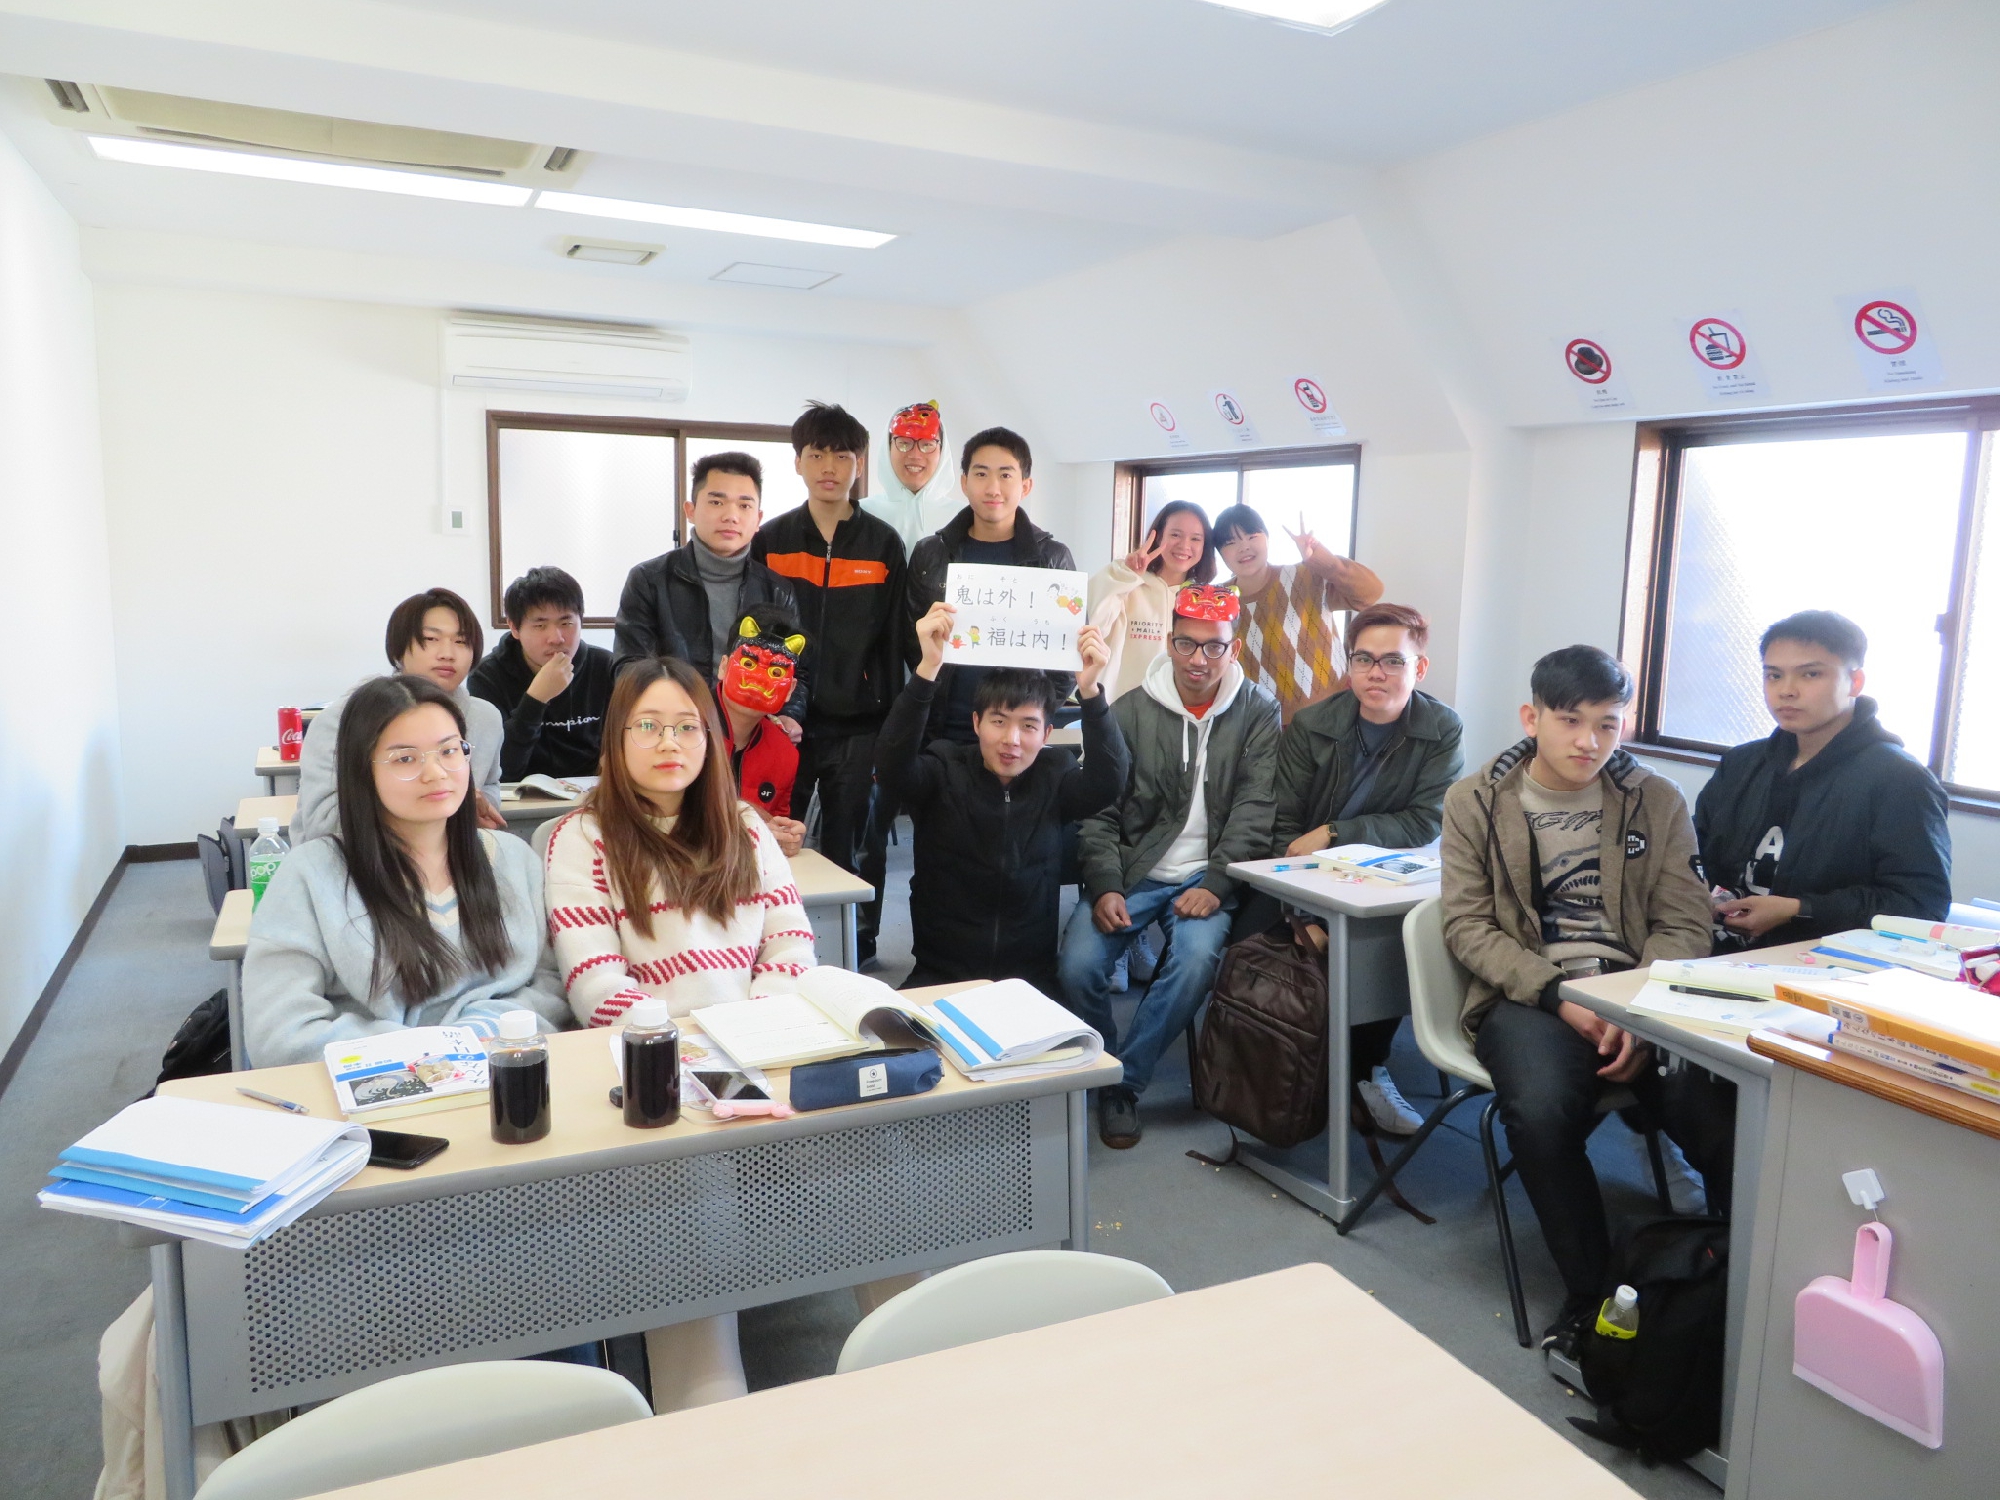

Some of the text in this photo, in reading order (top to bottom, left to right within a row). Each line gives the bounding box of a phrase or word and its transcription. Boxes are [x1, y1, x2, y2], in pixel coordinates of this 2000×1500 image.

[955, 585, 1034, 609] 鬼は外！
[986, 626, 1066, 651] 福は内！
[1129, 633, 1162, 641] EXPRESS
